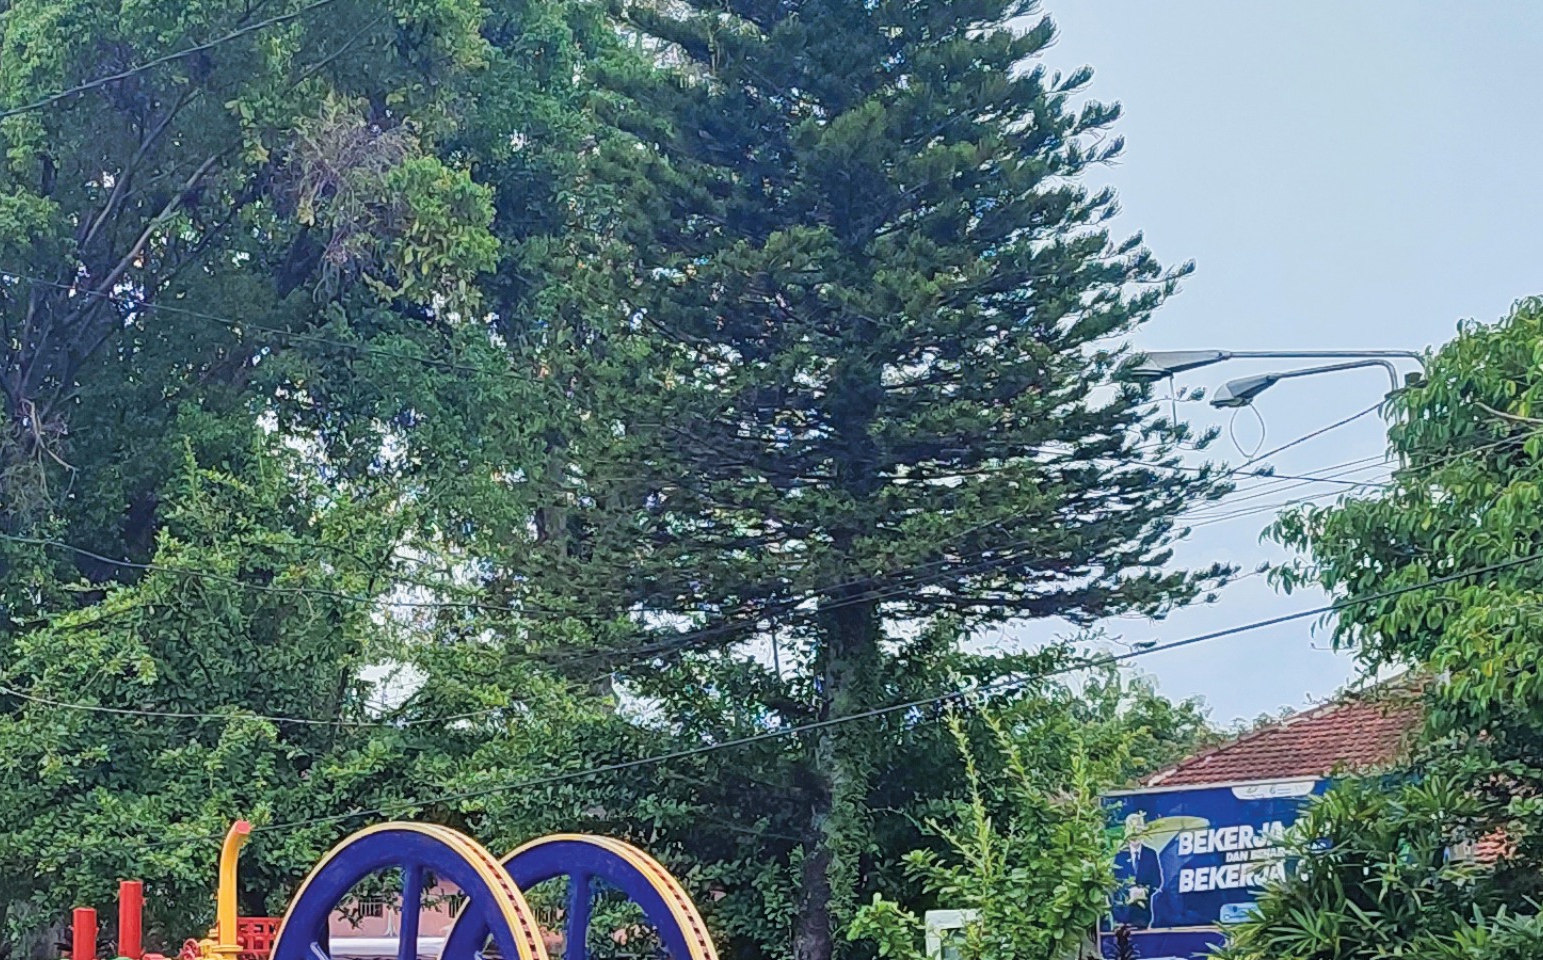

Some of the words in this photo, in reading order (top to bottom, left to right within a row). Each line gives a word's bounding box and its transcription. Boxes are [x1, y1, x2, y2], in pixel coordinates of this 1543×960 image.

[1178, 821, 1286, 856] BEKERJA
[1225, 850, 1249, 863] DAN
[1178, 861, 1287, 893] BEKERJA
